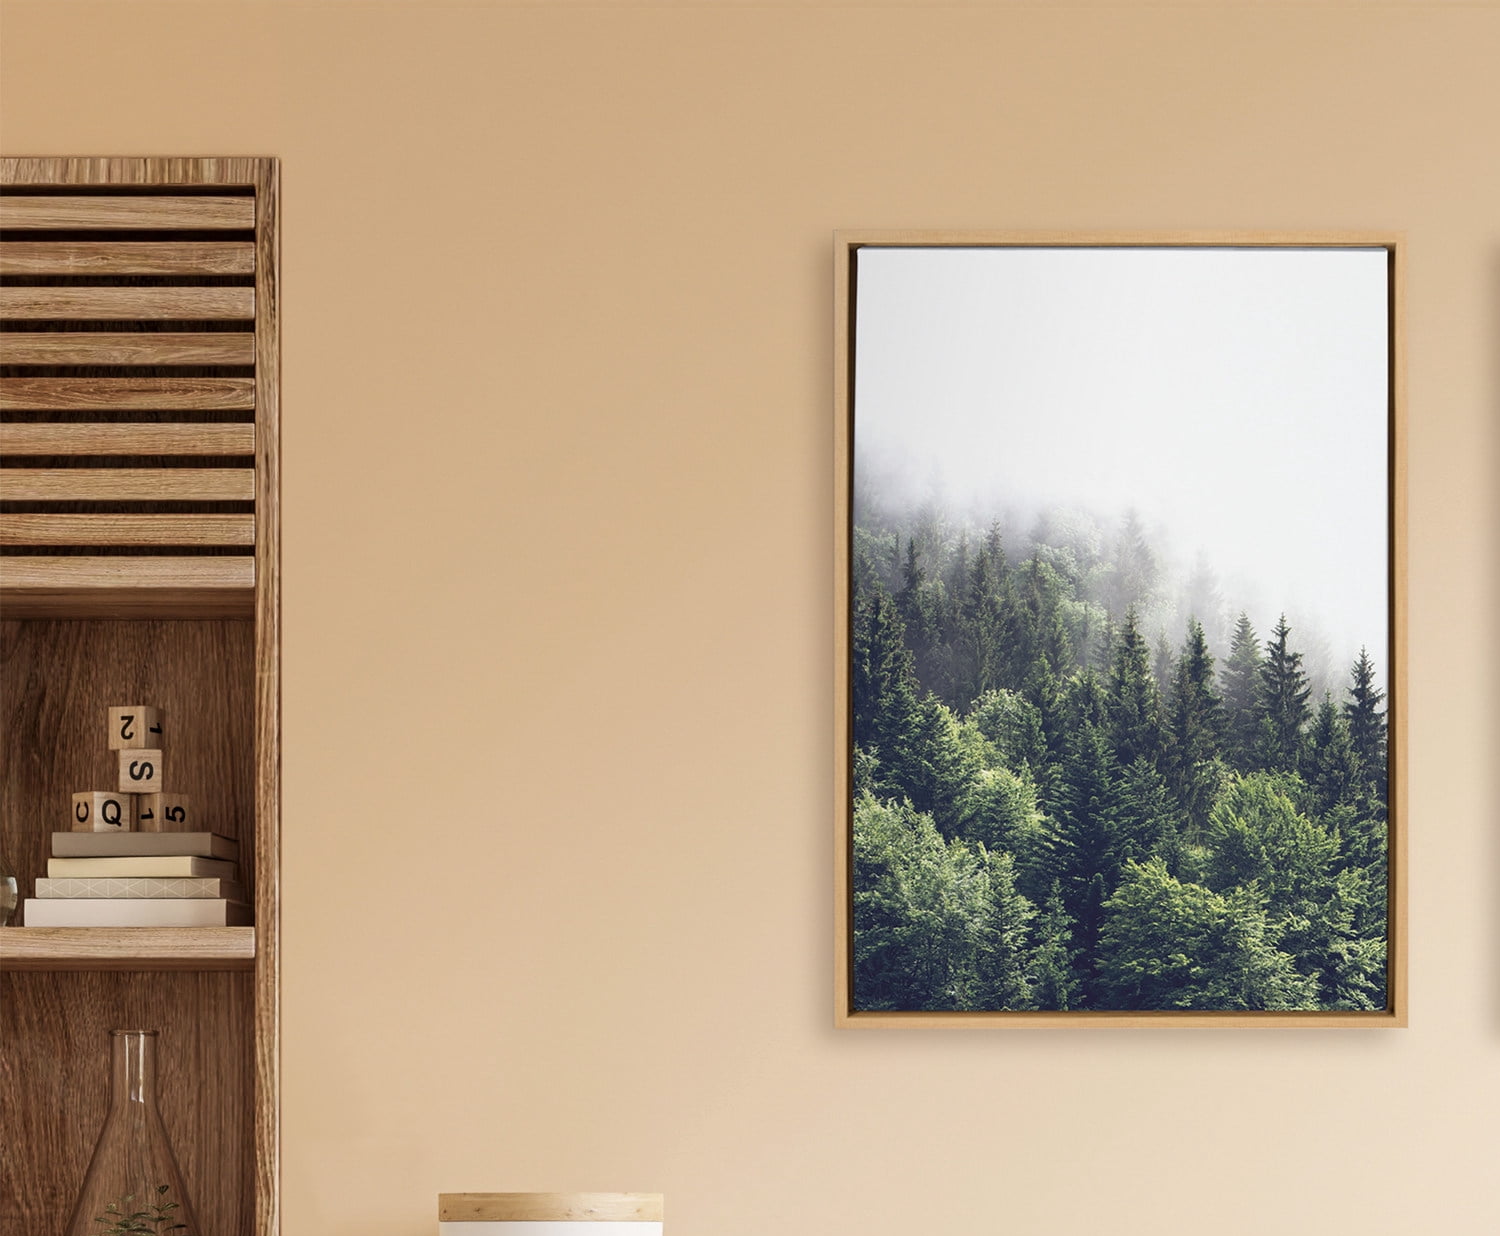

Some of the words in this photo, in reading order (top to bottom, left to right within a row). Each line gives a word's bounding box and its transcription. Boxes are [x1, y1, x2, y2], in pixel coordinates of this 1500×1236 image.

[120, 715, 134, 740] 2
[129, 760, 154, 781] S
[101, 799, 122, 827] Q
[165, 806, 186, 823] 5
